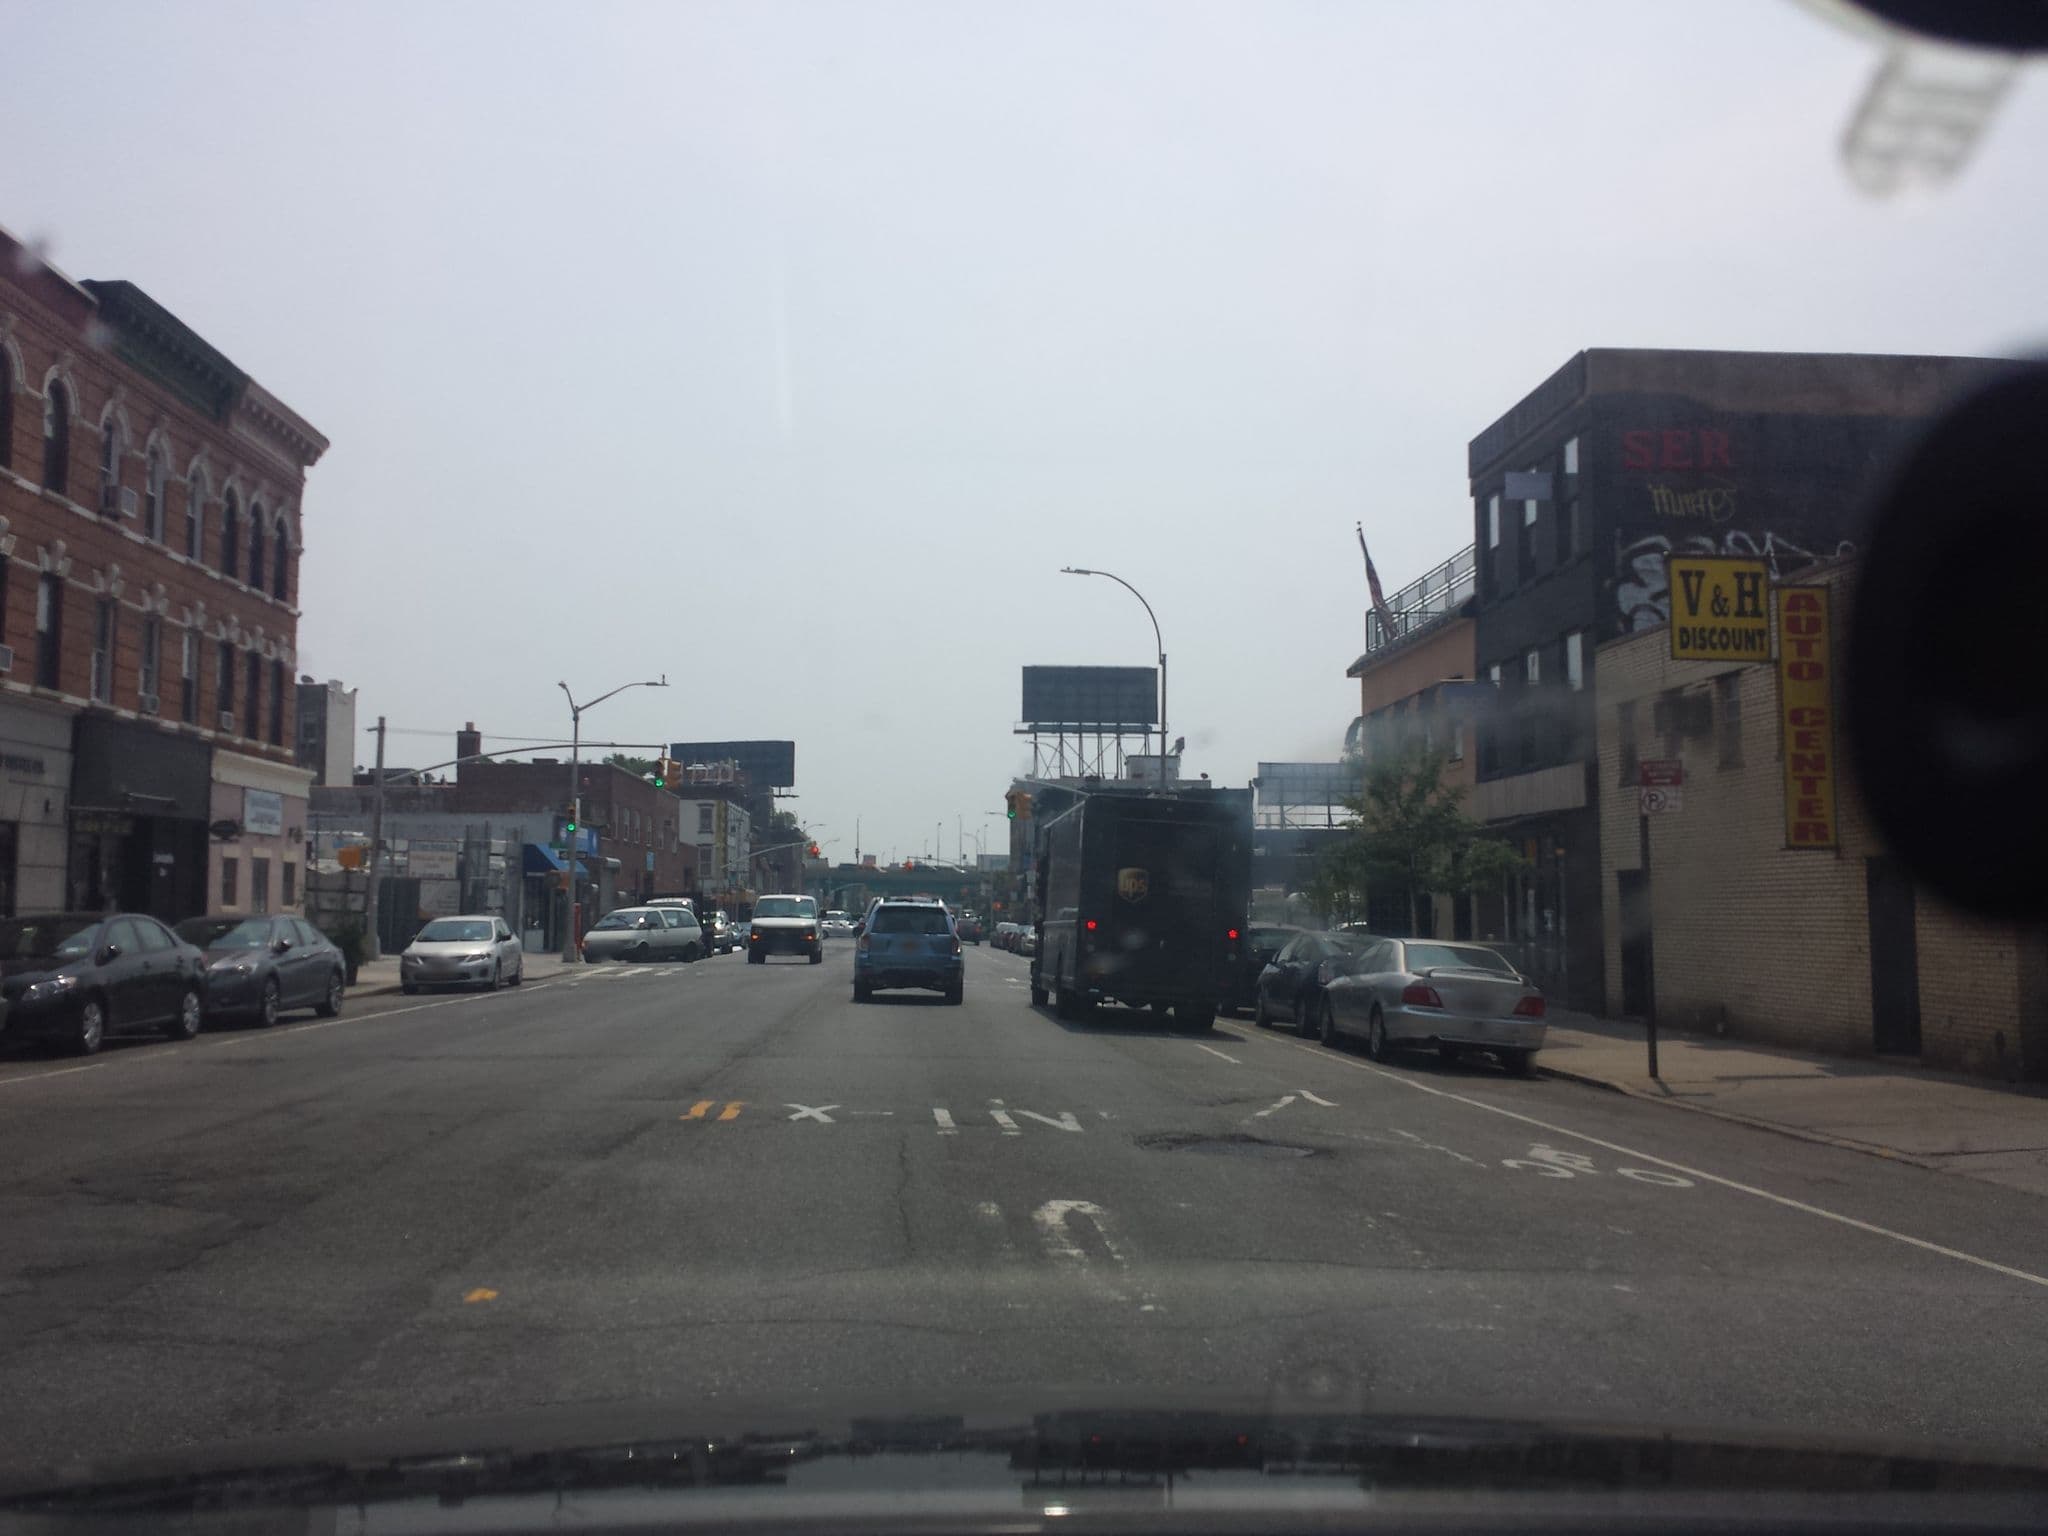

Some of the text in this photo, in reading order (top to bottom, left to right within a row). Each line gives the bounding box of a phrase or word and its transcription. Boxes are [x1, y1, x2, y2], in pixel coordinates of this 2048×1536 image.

[1623, 431, 1730, 470] SER
[1680, 570, 1704, 616] V
[1711, 585, 1730, 617] &
[1734, 572, 1763, 617] H
[1680, 626, 1766, 652] DISCOUNT
[1784, 594, 1824, 681] AUTO
[1787, 706, 1829, 842] CENTER
